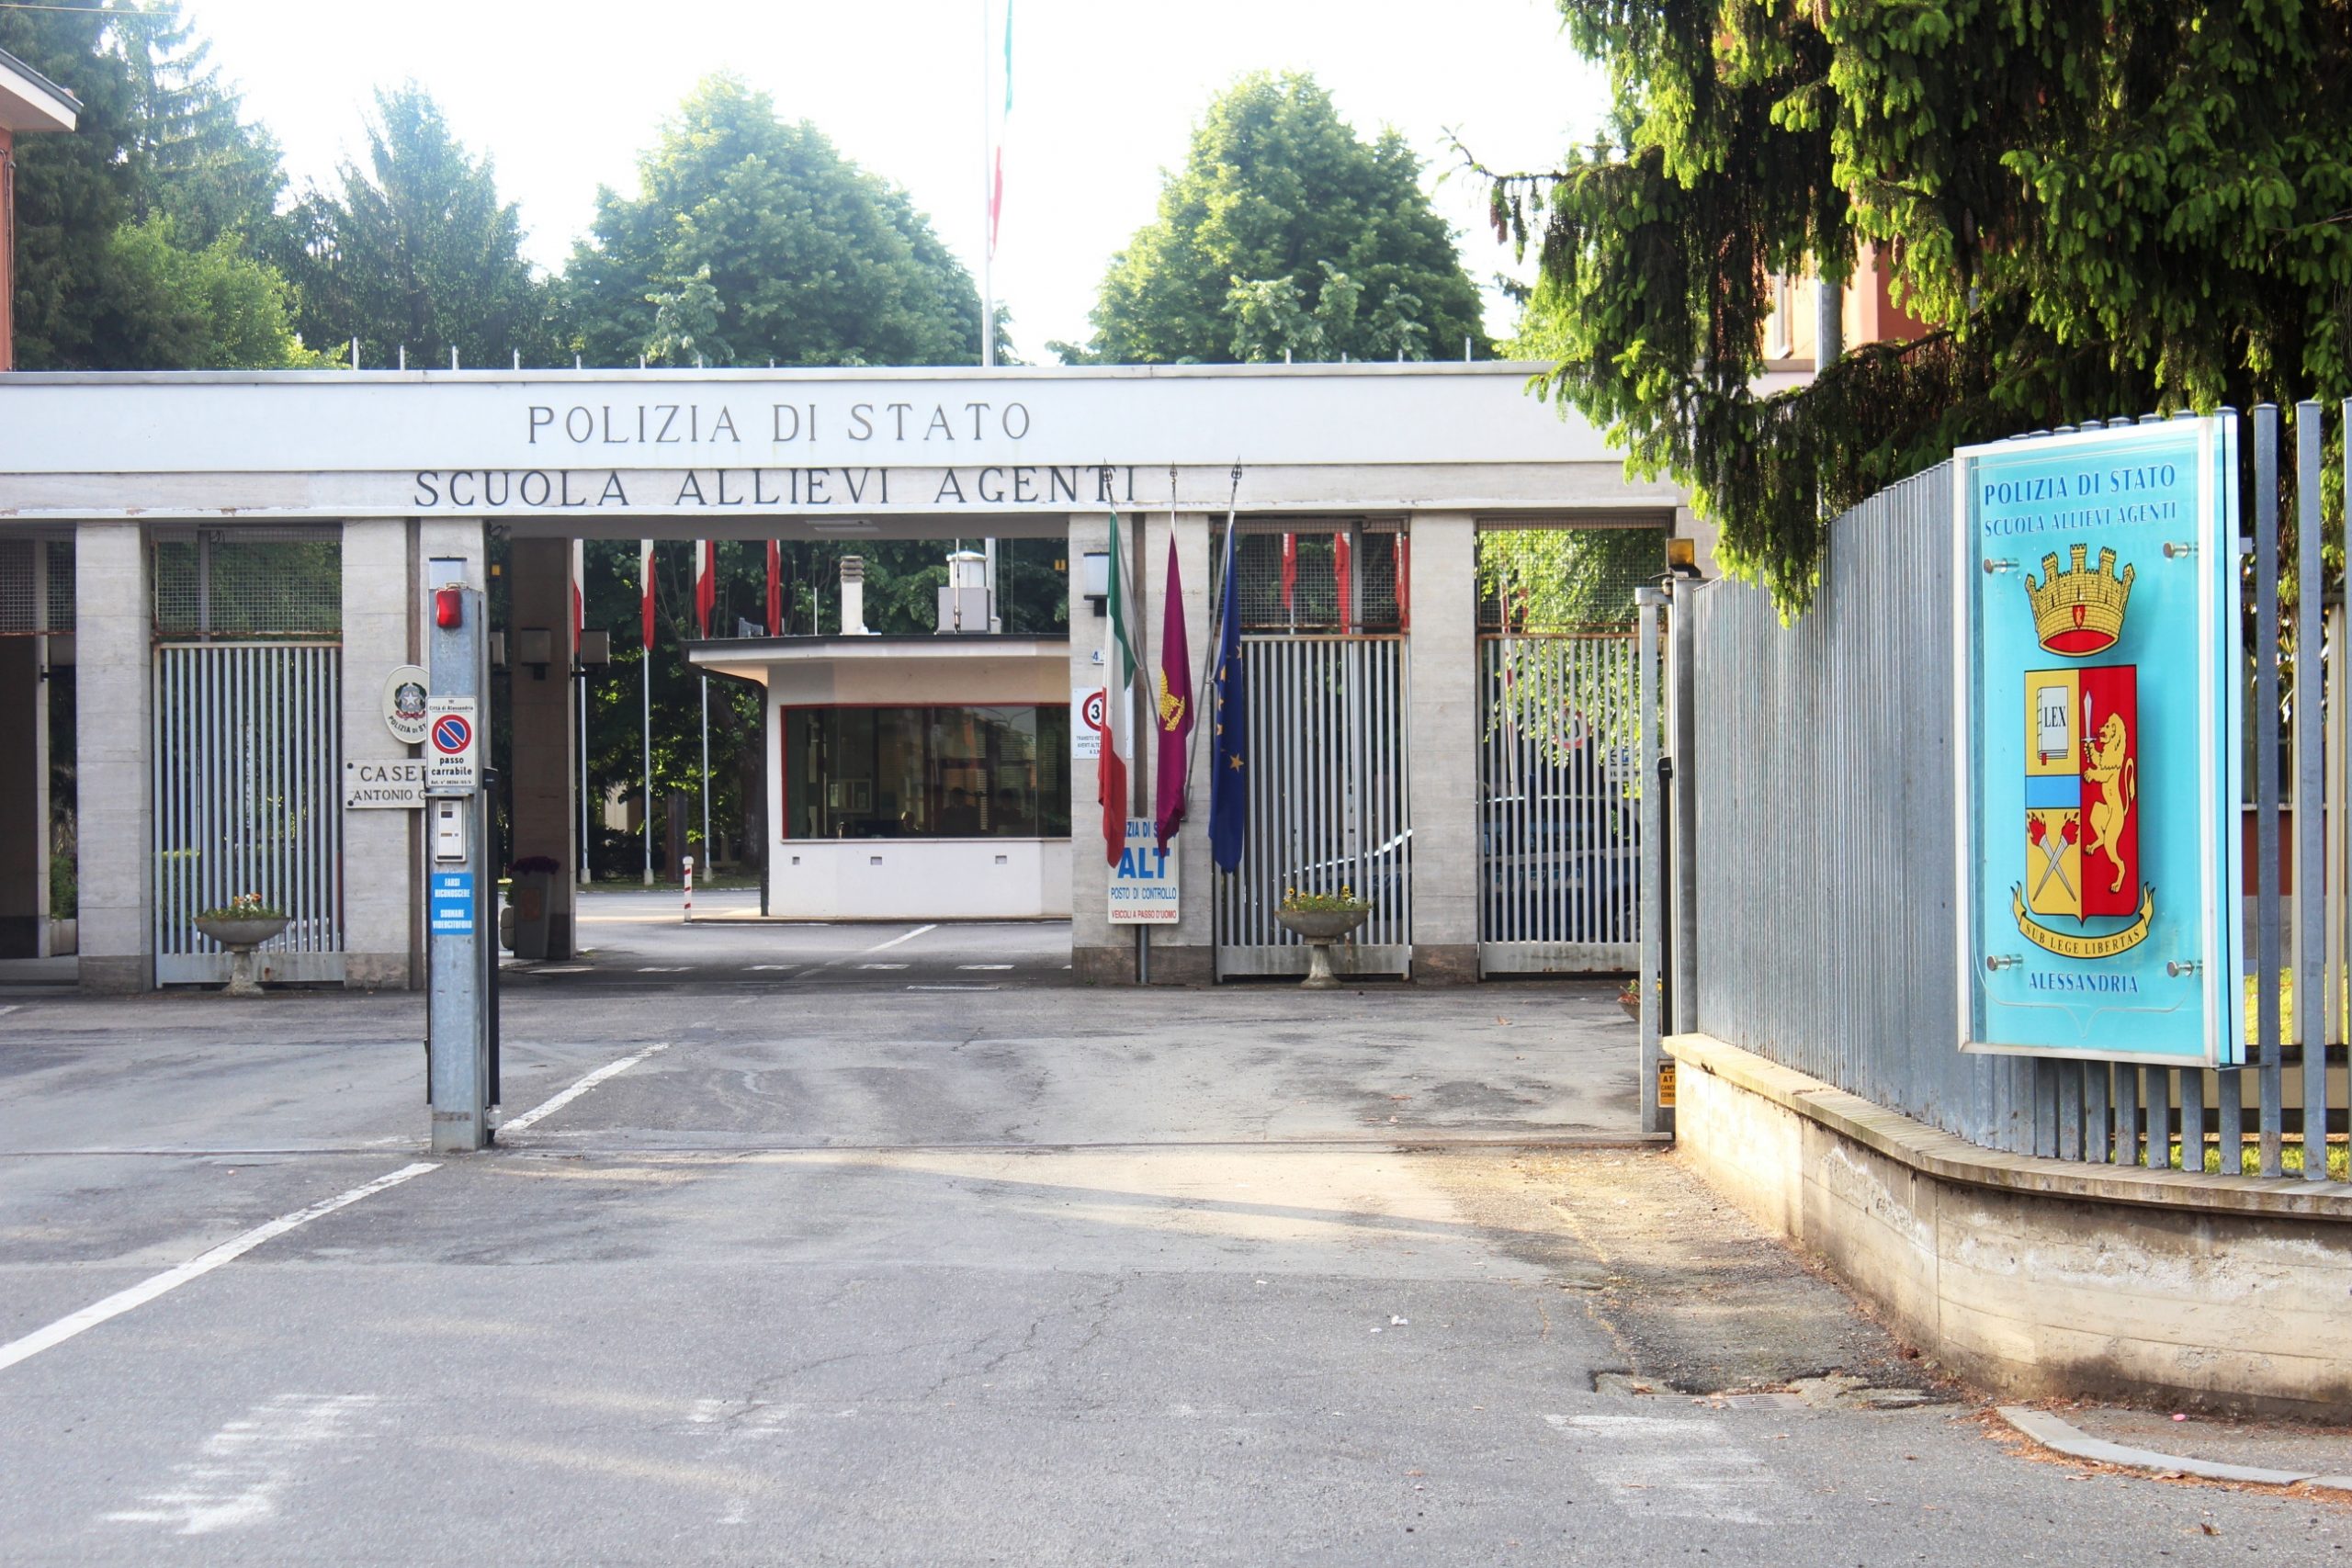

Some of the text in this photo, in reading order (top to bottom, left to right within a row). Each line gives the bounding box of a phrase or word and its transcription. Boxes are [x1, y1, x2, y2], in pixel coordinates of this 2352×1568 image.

[528, 402, 1030, 444] POLIZIA DI STATO
[414, 466, 1135, 507] SCUOLA ALLIEVI AGENTI
[1984, 465, 2176, 505] POLIZIA DI STATO
[1984, 502, 2177, 536] SCUOLA ALLIEVI AGENTI
[388, 715, 411, 733] POLIZIA
[2044, 705, 2066, 728] LEX
[439, 757, 464, 766] passo
[360, 766, 425, 782] CASE
[431, 767, 472, 776] carrabile
[353, 790, 413, 801] ANTONIO
[1143, 821, 1150, 838] DI
[1117, 847, 1170, 878] ALT
[1111, 887, 1177, 899] POSTO DI CONTROLLO
[1112, 909, 1177, 919] VEICOLI A PASSO D'UOMO
[2025, 924, 2140, 954] SUB LEGE LIBERTAS
[2029, 972, 2139, 993] ALESSANDRIA
